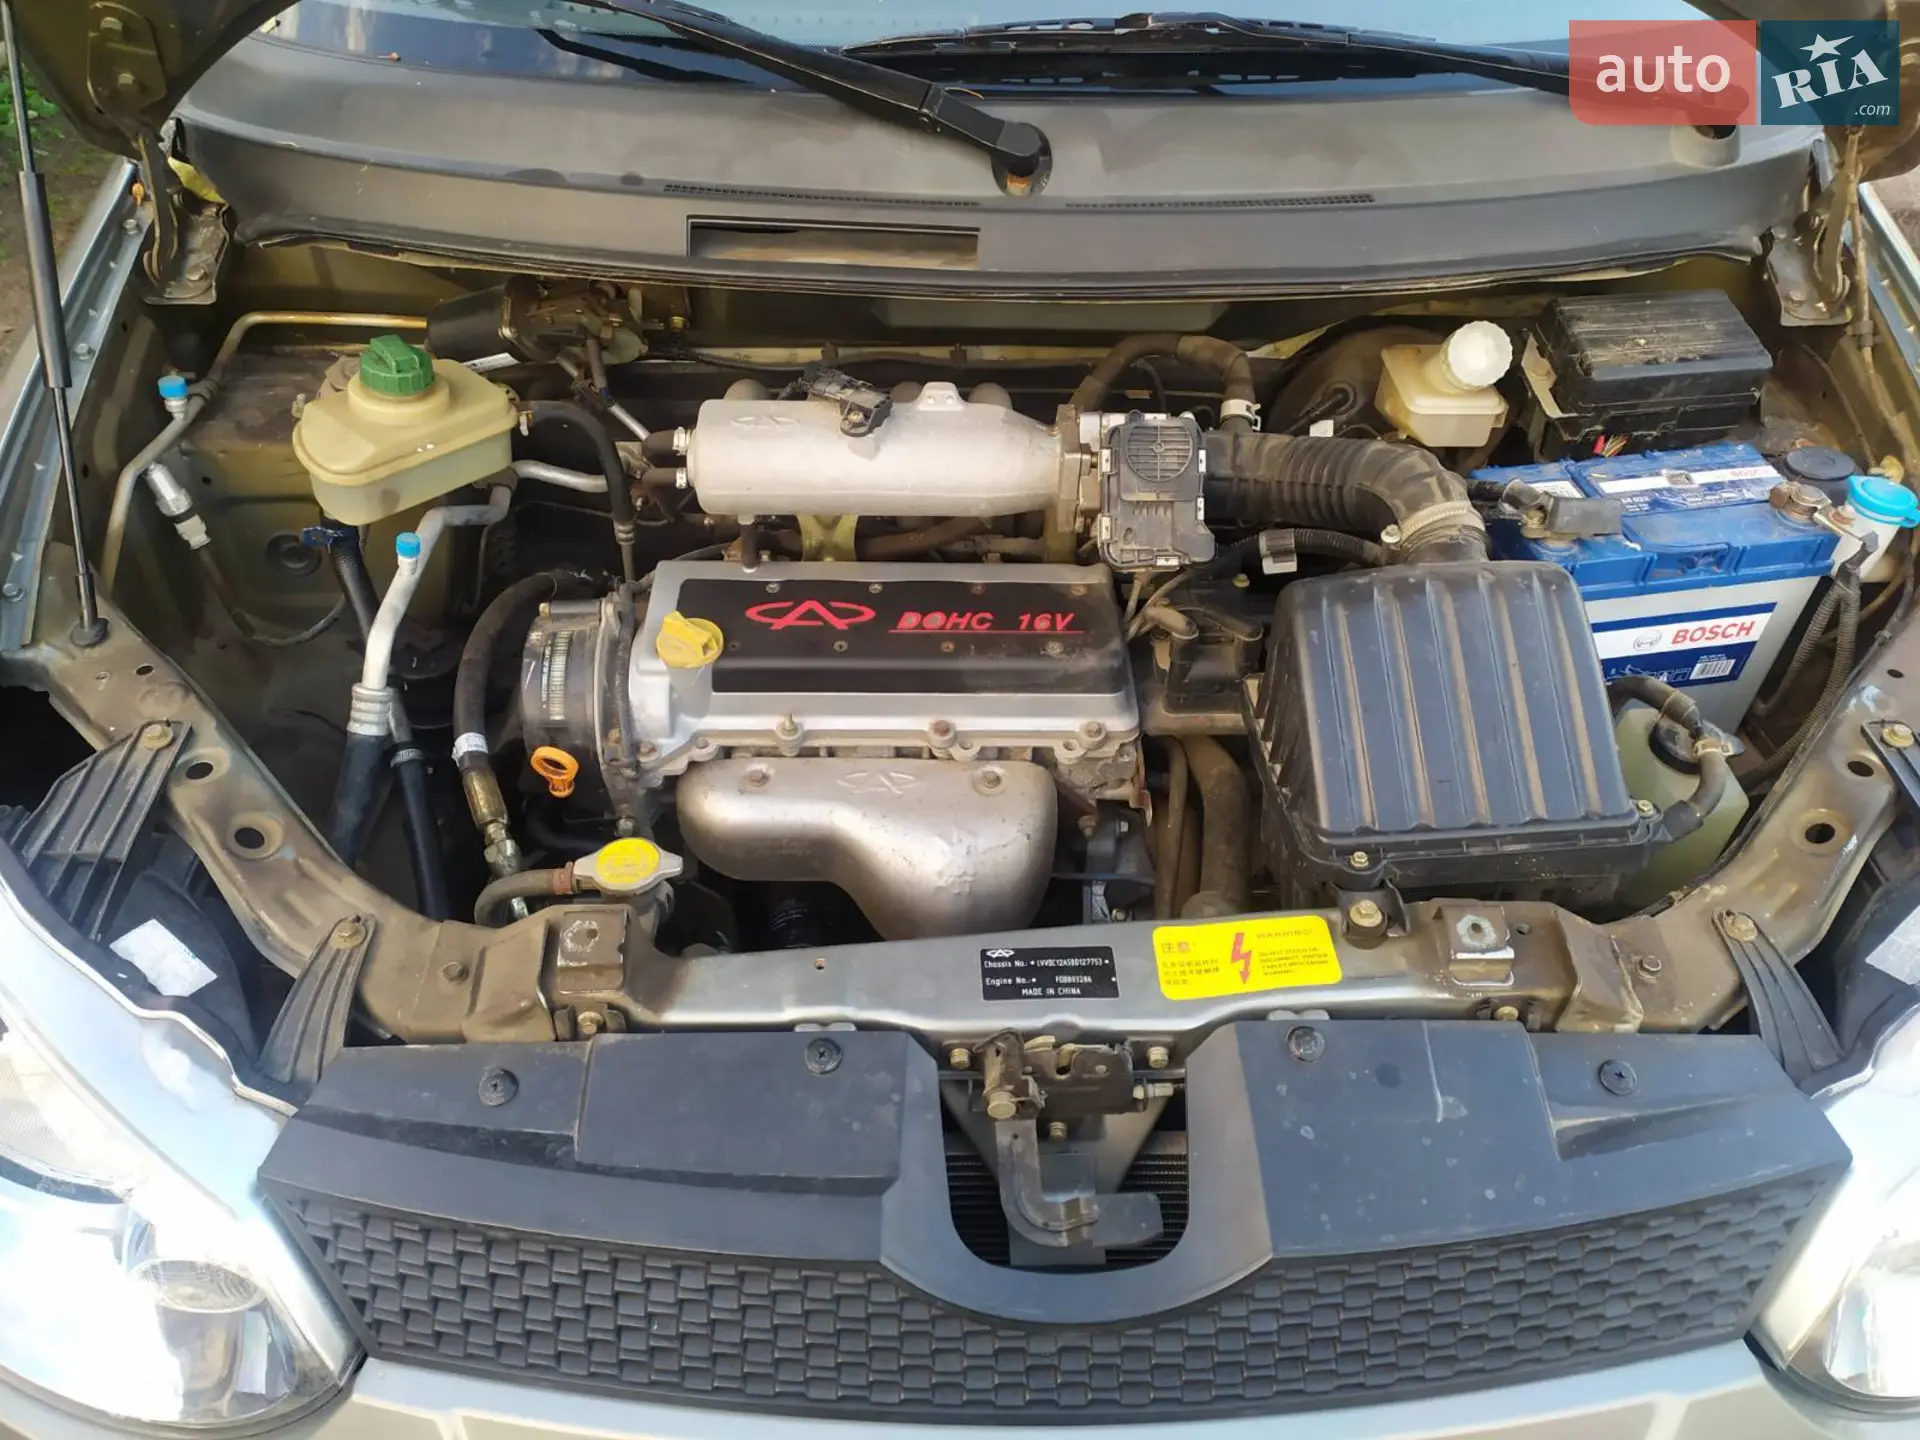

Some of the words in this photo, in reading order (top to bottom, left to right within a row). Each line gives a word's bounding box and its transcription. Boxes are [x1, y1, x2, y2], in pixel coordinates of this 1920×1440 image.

[896, 611, 994, 630] DOHC
[1018, 612, 1075, 630] 16V
[1671, 621, 1755, 645] BOSCH
[984, 960, 1012, 968] Chassis
[985, 977, 1012, 987] Engine
[1021, 987, 1043, 996] MADE
[1046, 987, 1055, 995] IN
[1057, 987, 1081, 995] CHINA
